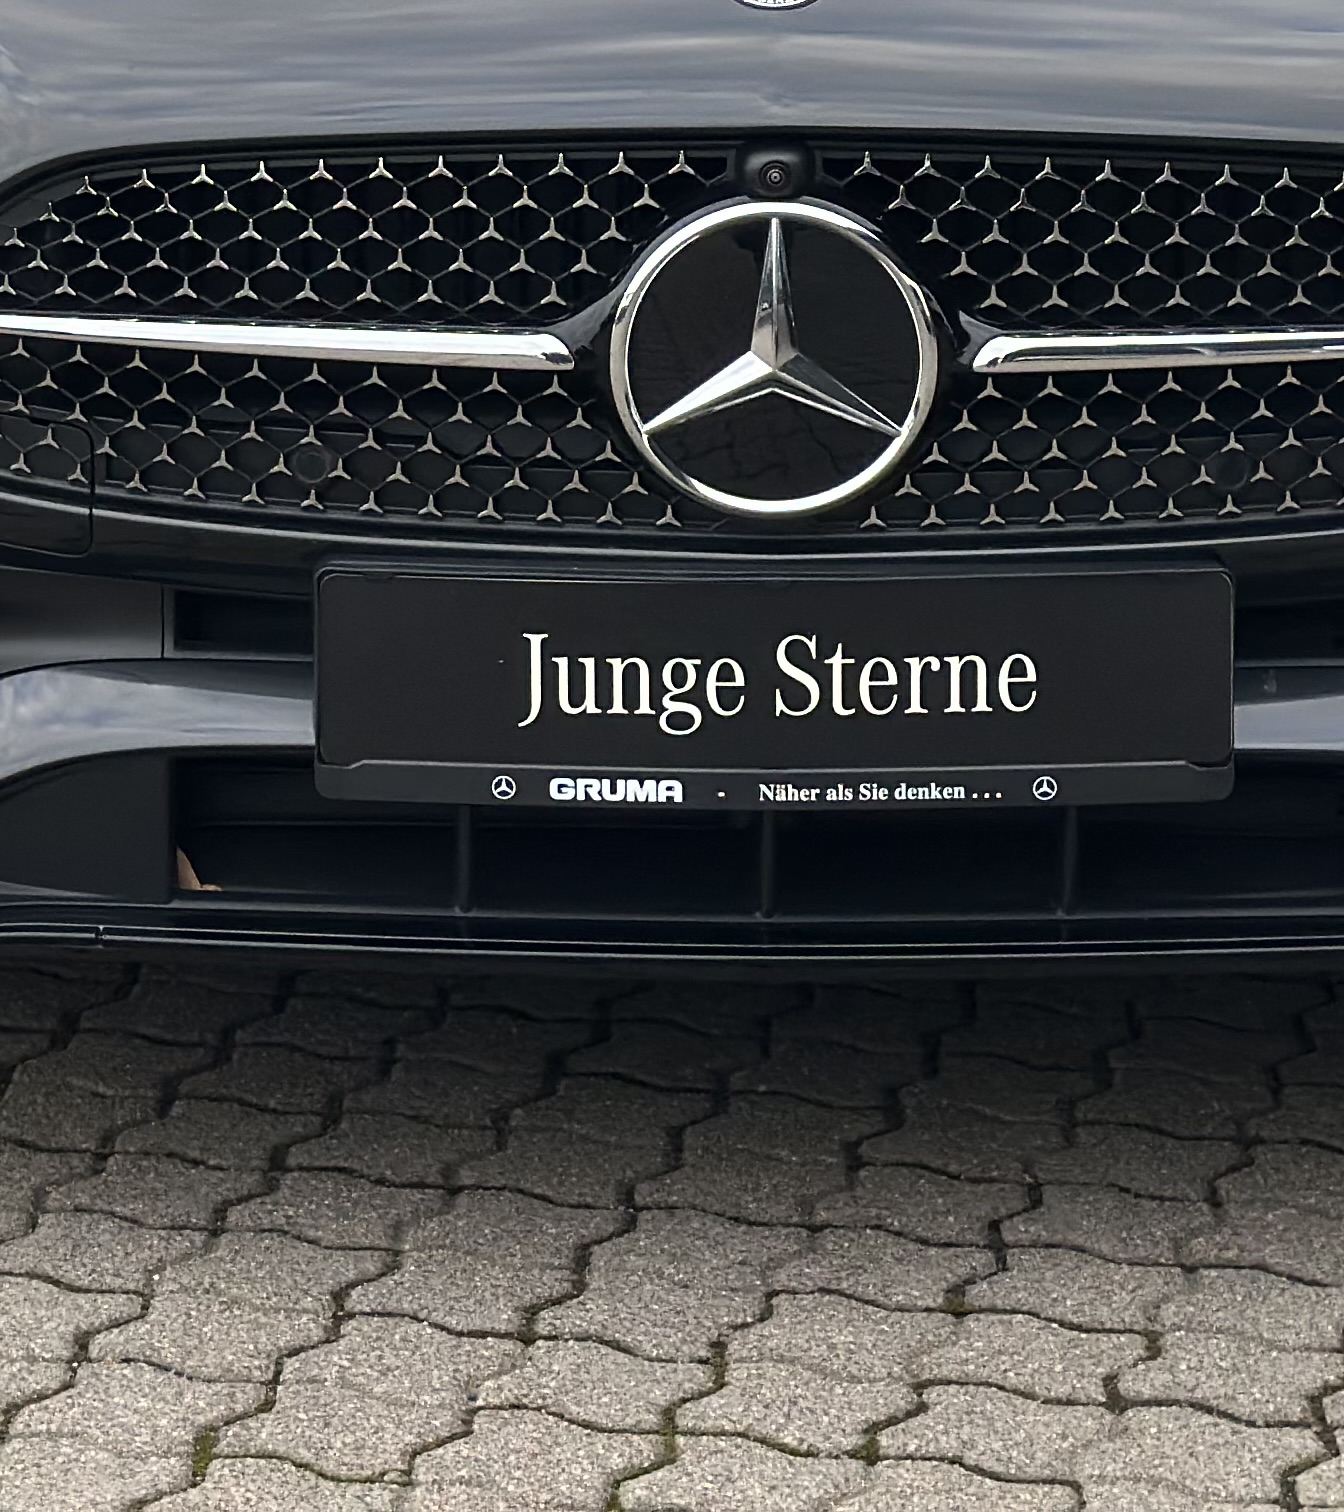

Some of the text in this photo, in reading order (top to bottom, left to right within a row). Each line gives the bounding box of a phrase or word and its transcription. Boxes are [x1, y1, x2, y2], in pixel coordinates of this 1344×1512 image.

[518, 633, 1037, 735] Junge Sterne
[549, 777, 683, 803] GRUMA
[758, 783, 820, 801] Näher
[825, 784, 854, 801] als
[858, 783, 889, 801] Sie
[894, 783, 966, 800] denken
